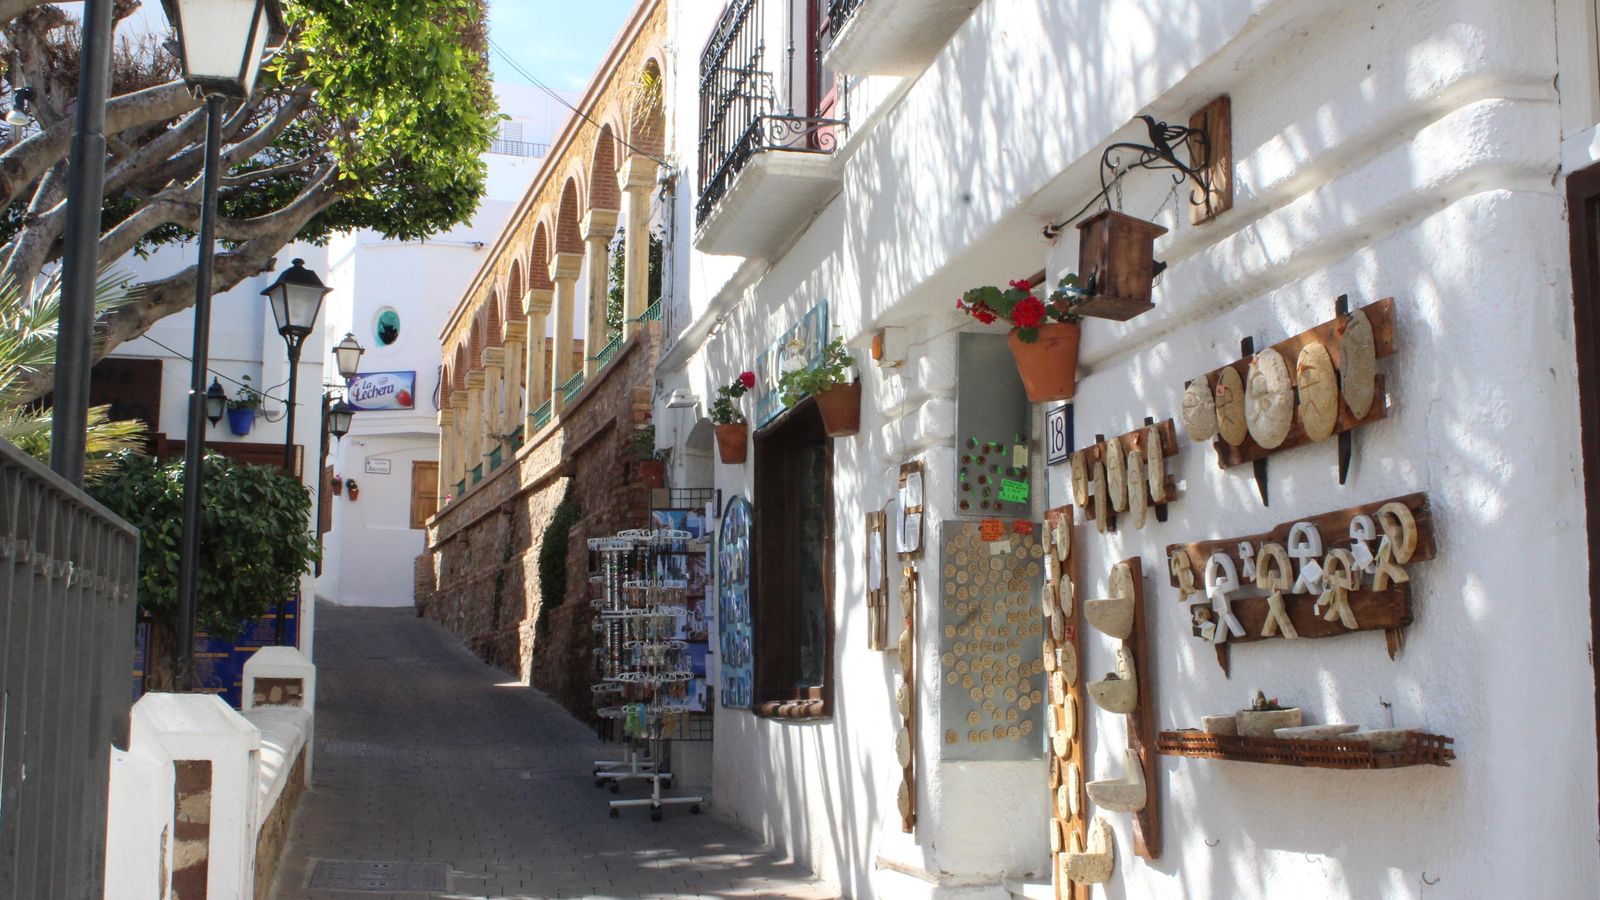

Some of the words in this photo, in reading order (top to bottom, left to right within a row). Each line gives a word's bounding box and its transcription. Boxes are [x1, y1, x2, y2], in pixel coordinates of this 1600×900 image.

[353, 384, 395, 402] Lechera
[362, 379, 373, 390] La
[1050, 416, 1064, 454] 18
